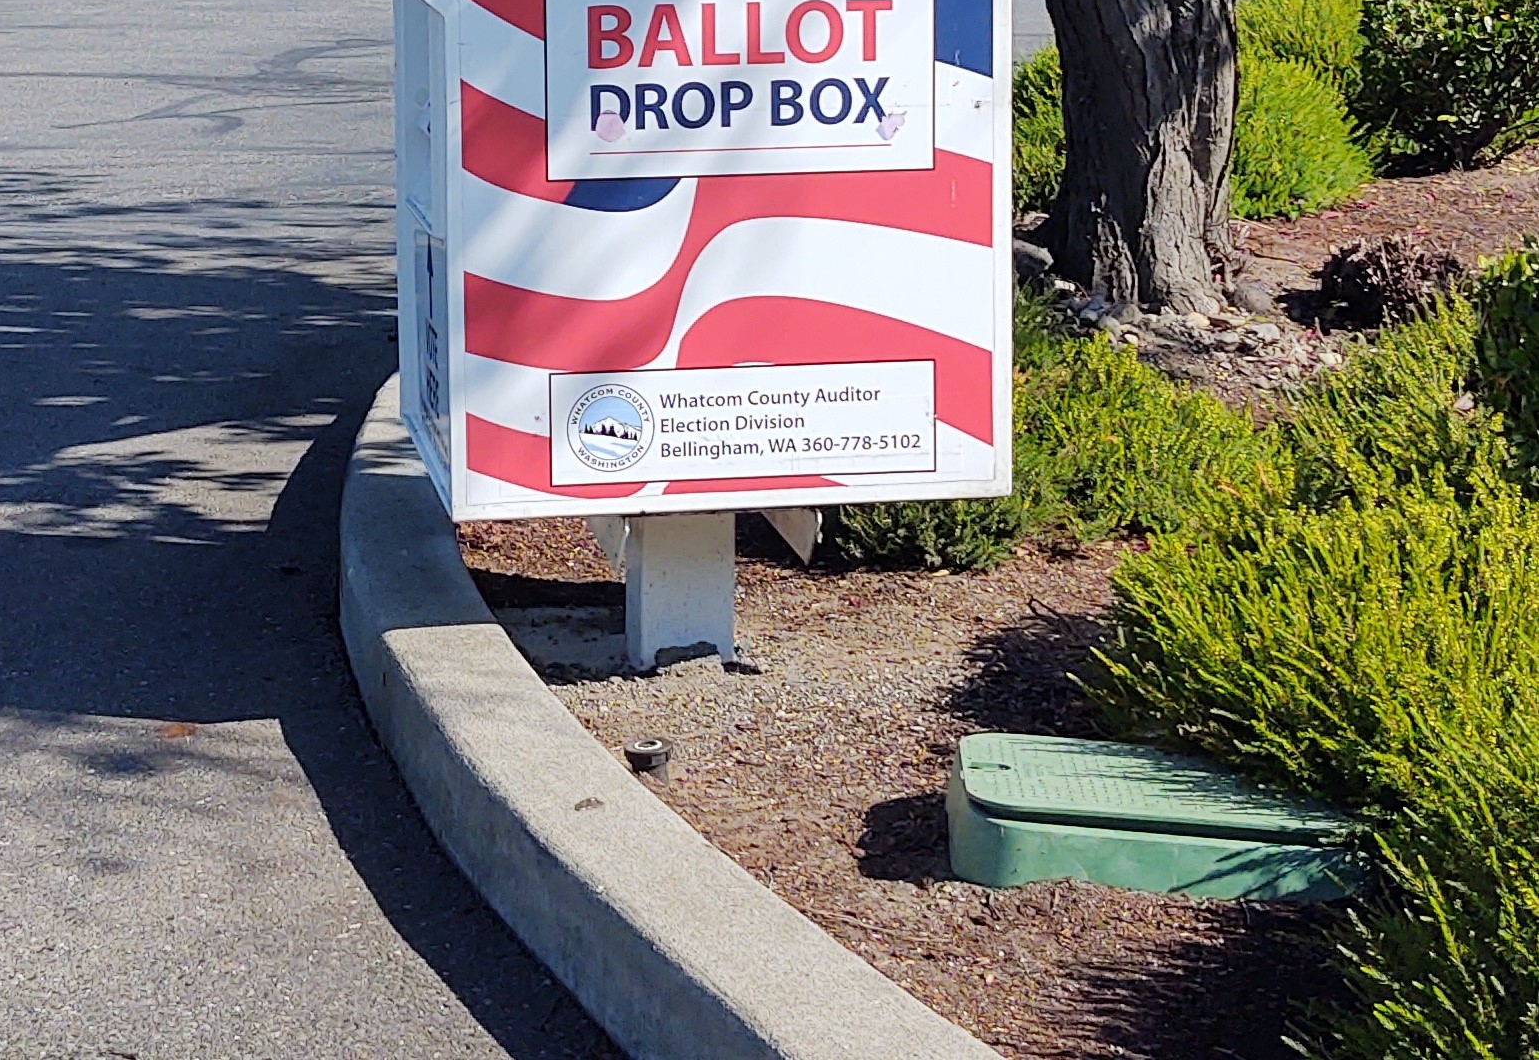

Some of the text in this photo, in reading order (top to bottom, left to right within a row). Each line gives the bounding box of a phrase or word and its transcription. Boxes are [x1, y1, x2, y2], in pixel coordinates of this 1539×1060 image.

[590, 76, 890, 132] DROP BOX
[571, 388, 650, 425] WHATCOM COUNTY
[659, 386, 881, 409] Whatcom County Auditor
[660, 413, 805, 434] Election Division
[578, 444, 644, 469] WASHINGTON
[660, 434, 921, 461] Bellingham, WA 360-778-5102
